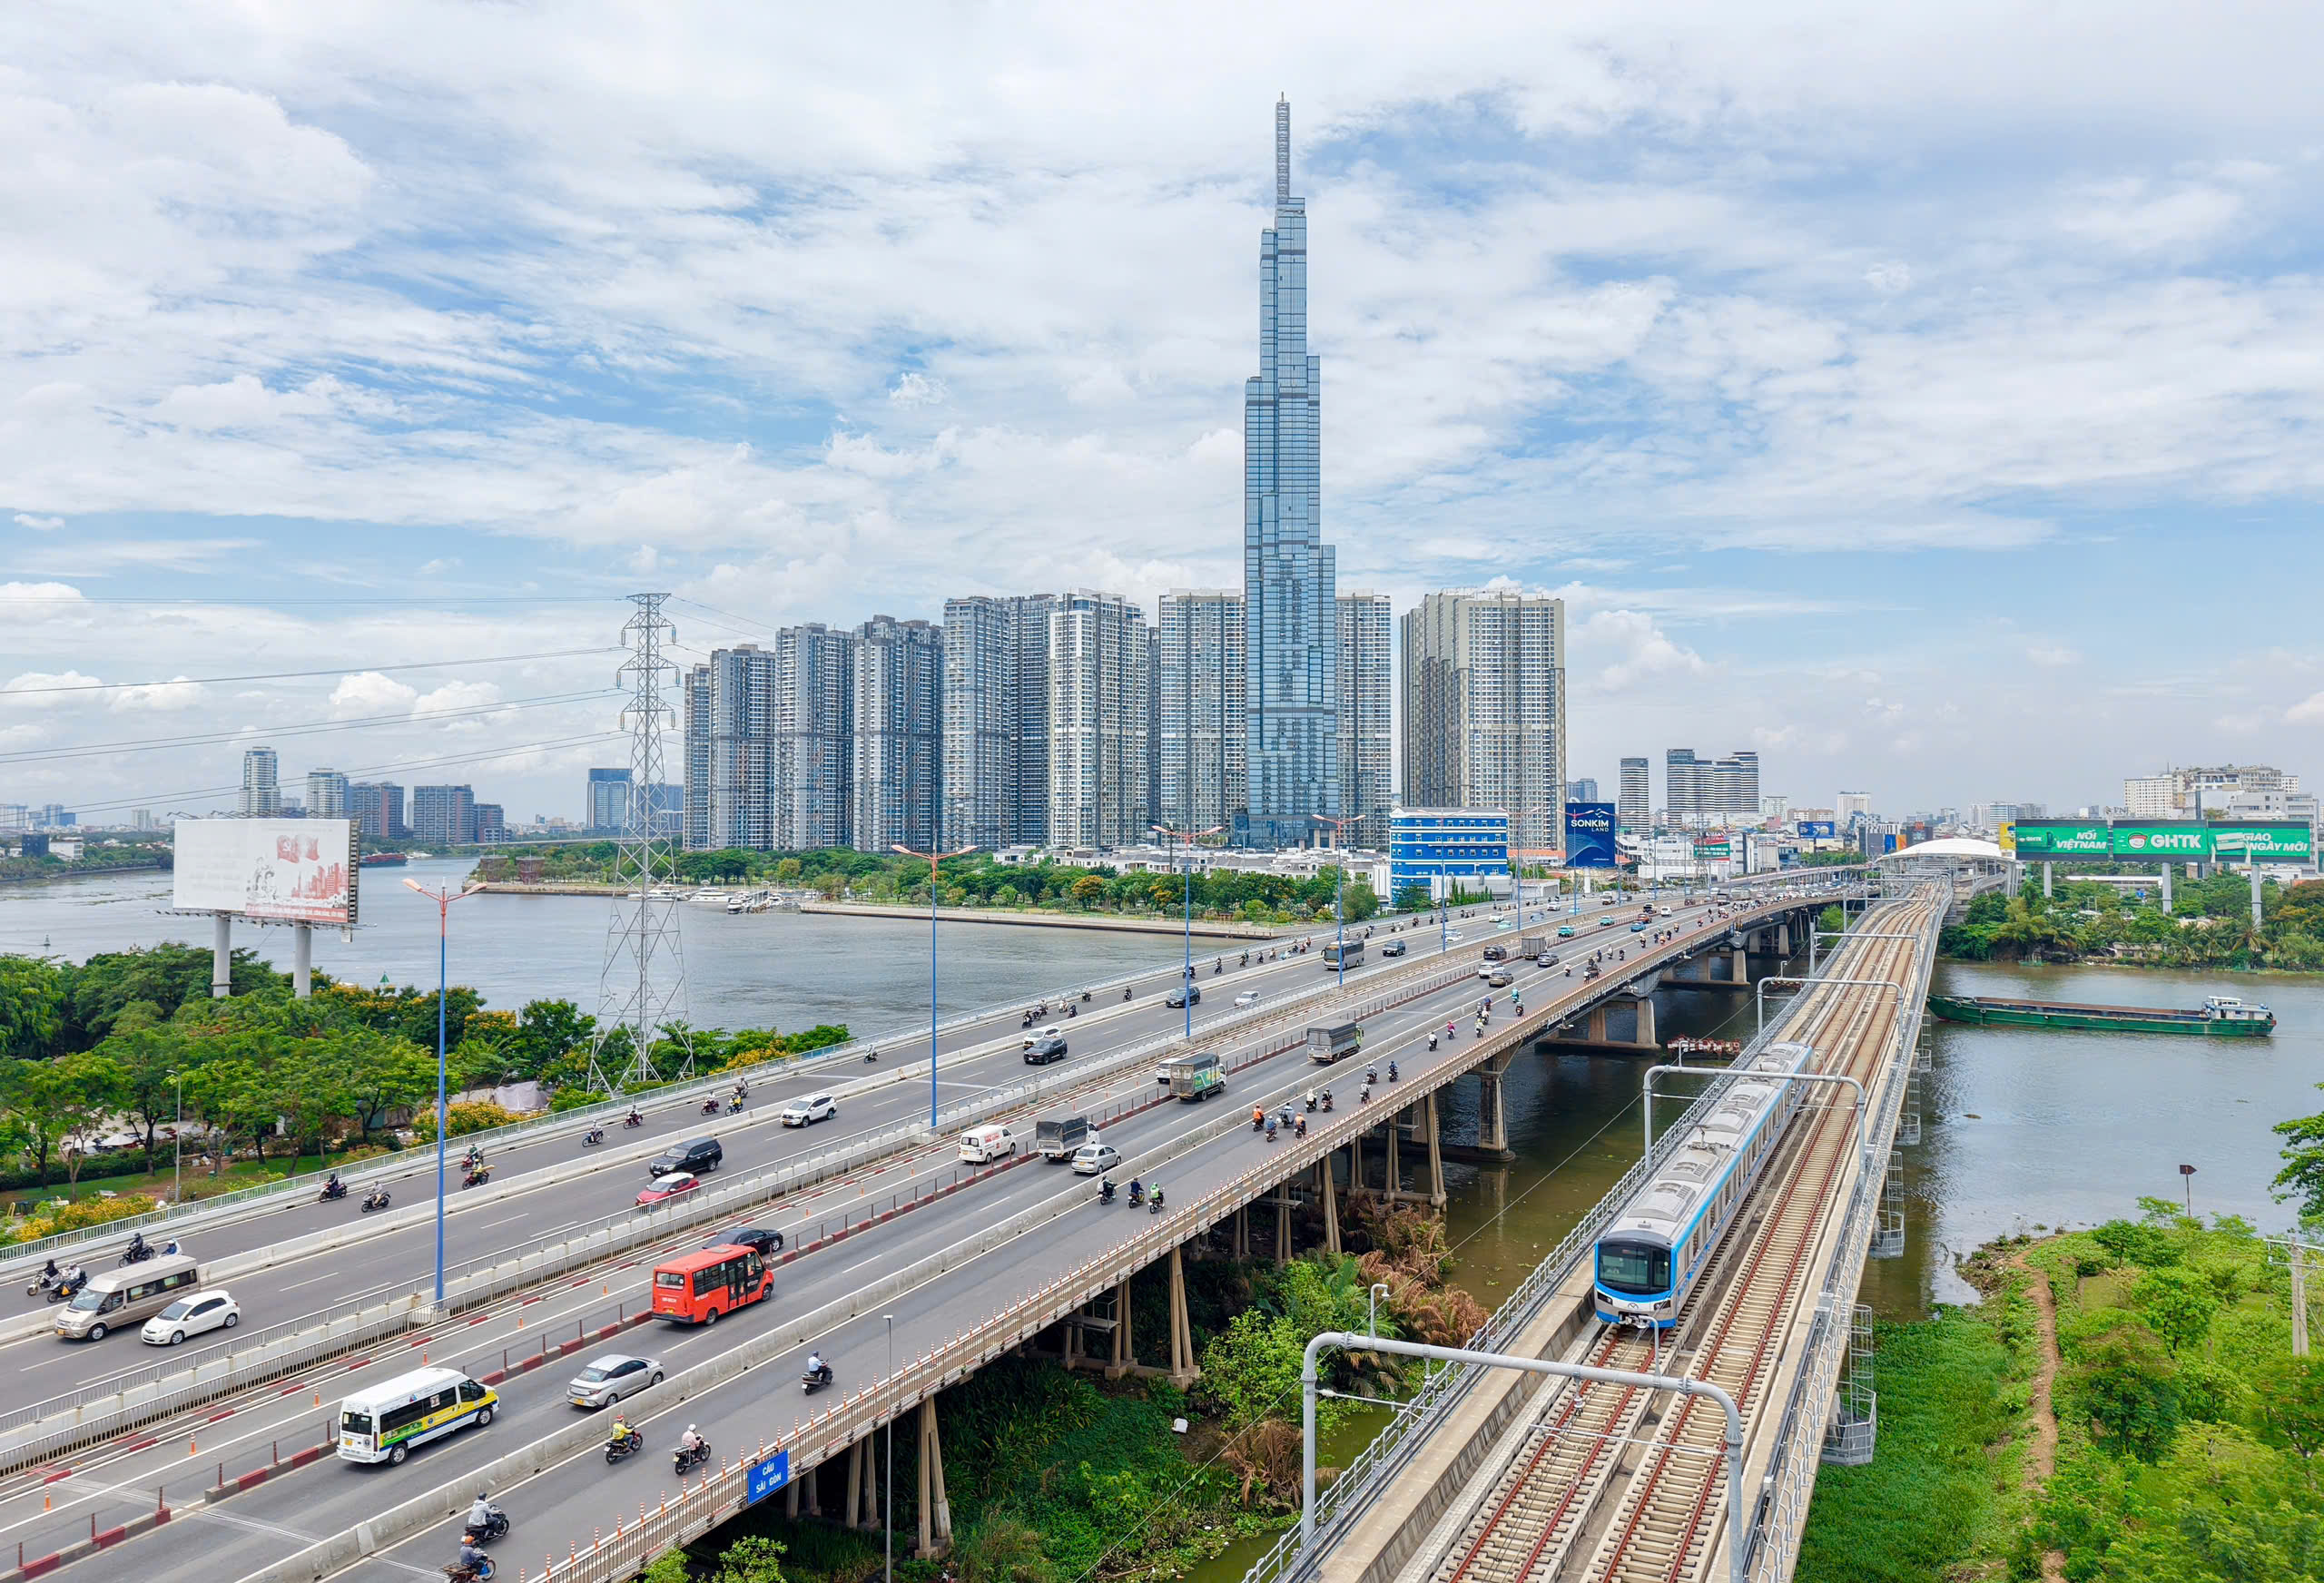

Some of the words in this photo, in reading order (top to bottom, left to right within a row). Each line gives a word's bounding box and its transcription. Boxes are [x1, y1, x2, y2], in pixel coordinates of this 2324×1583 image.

[2076, 829, 2098, 841] NỐI
[2151, 834, 2201, 848] GHTK
[2243, 832, 2271, 841] GIAO
[2248, 841, 2283, 851] NGÀY
[2282, 841, 2309, 851] MỚI
[756, 1480, 765, 1493] SÀI
[769, 1472, 781, 1486] GÒN
